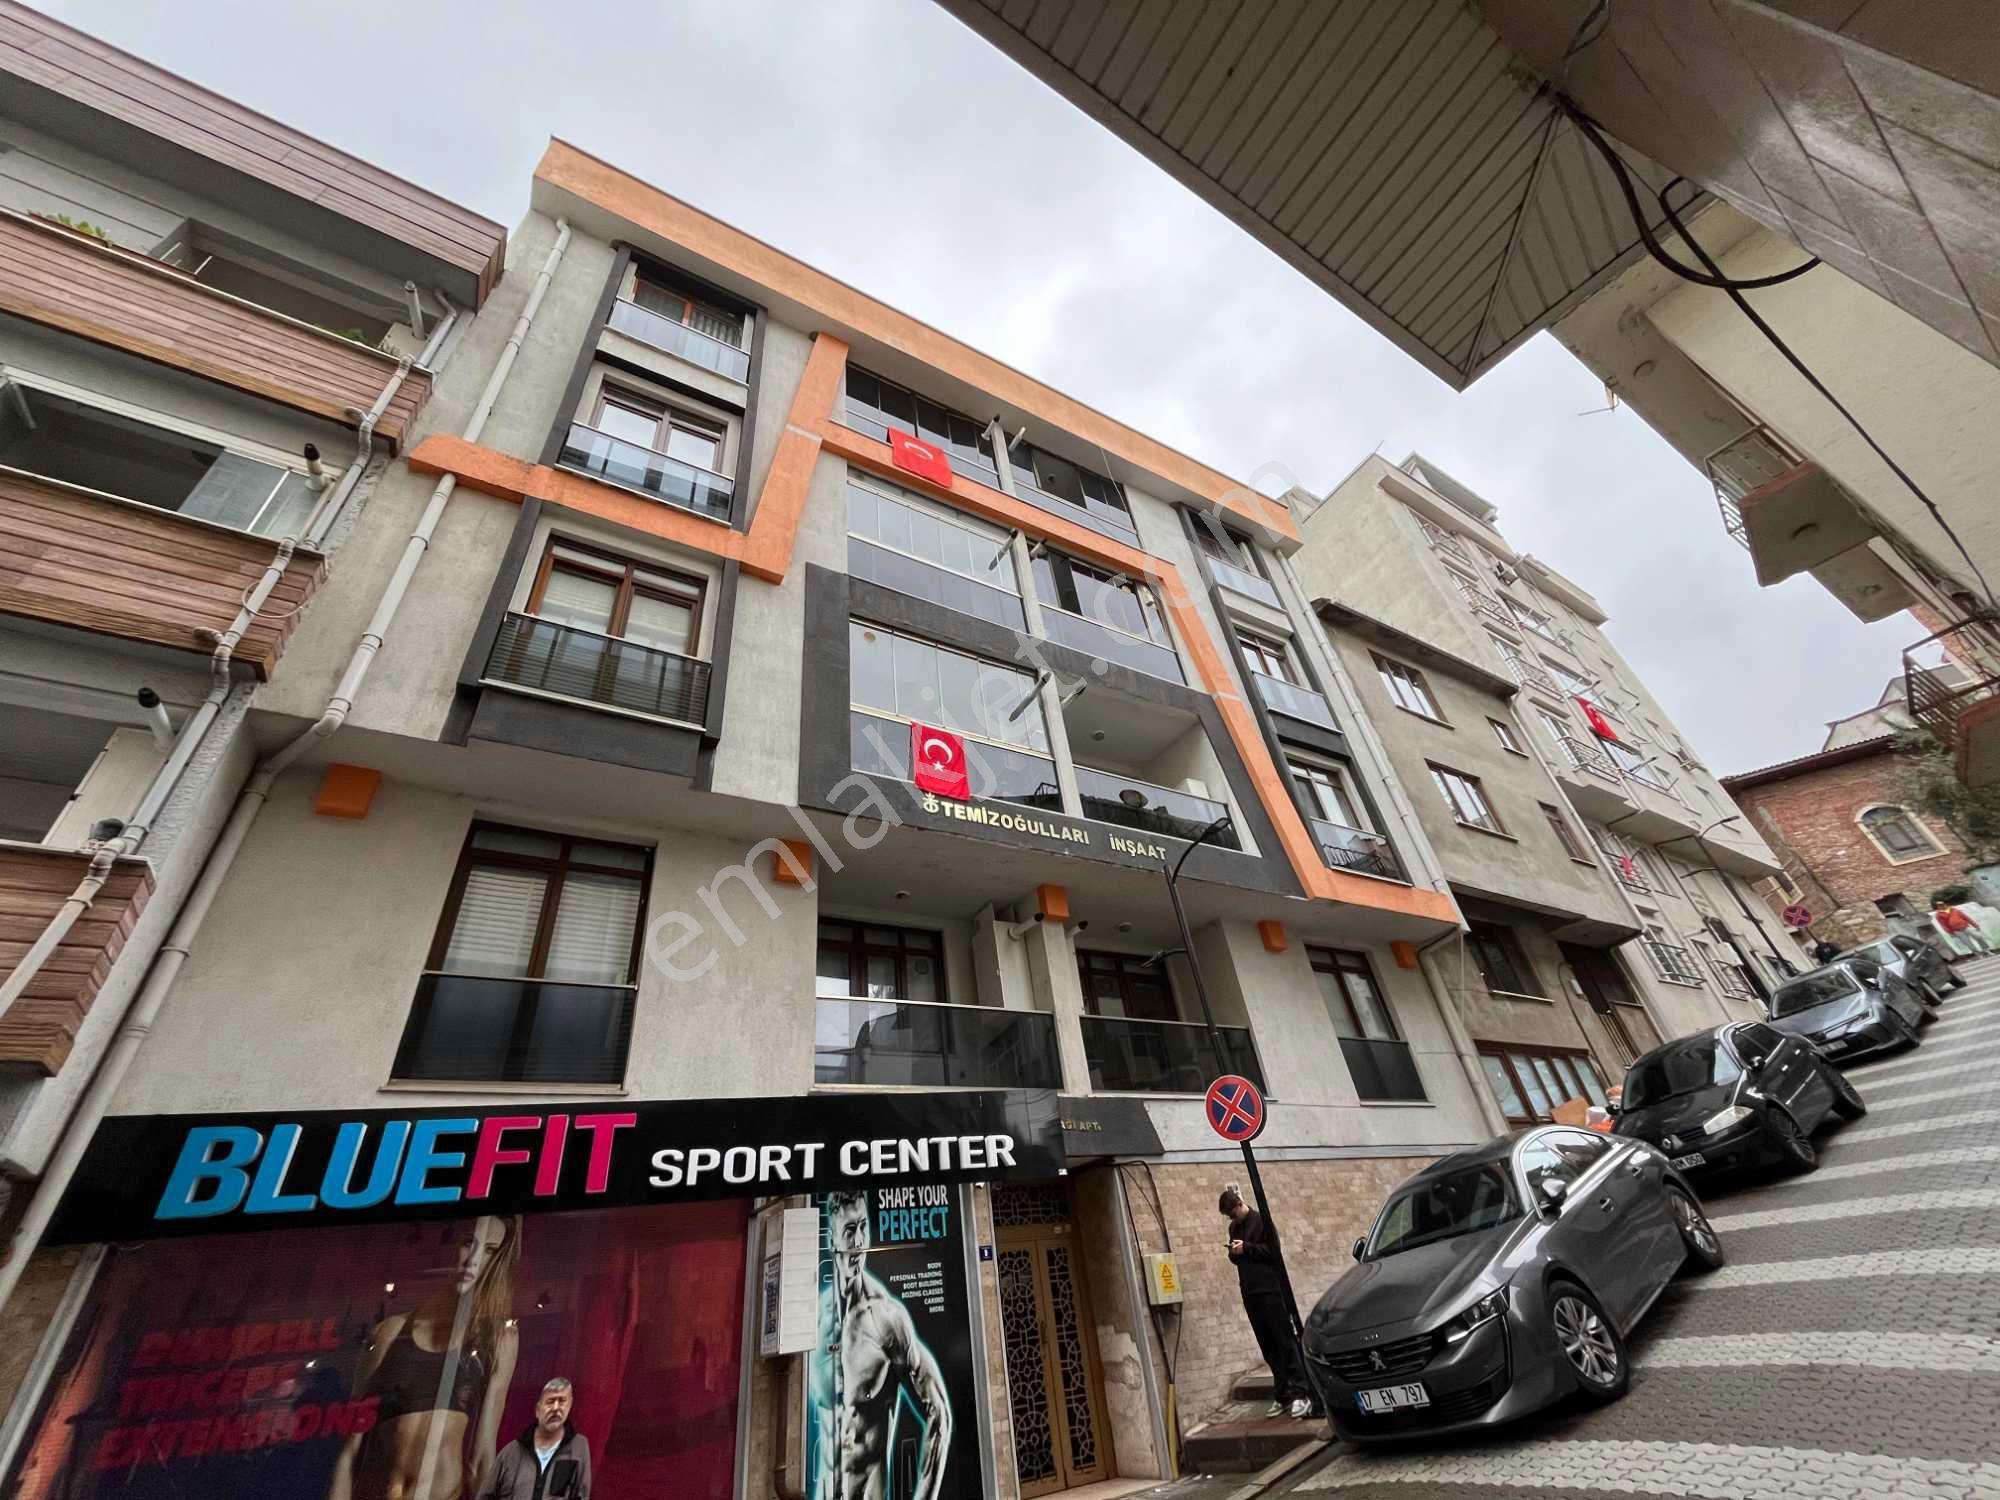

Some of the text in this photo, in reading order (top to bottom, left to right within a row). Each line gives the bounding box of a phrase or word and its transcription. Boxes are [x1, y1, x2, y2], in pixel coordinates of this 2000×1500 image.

[941, 800, 1167, 861] TEMİZOĞULLARI İNŞAAT
[155, 1113, 1017, 1220] BLUEFIT SPORT CENTER
[878, 1184, 949, 1209] SHAPE YOUR
[879, 1206, 949, 1242] PERFECT
[889, 1273, 917, 1282] PERSONAL
[1361, 1391, 1372, 1409] 17
[1401, 1384, 1423, 1403] 797
